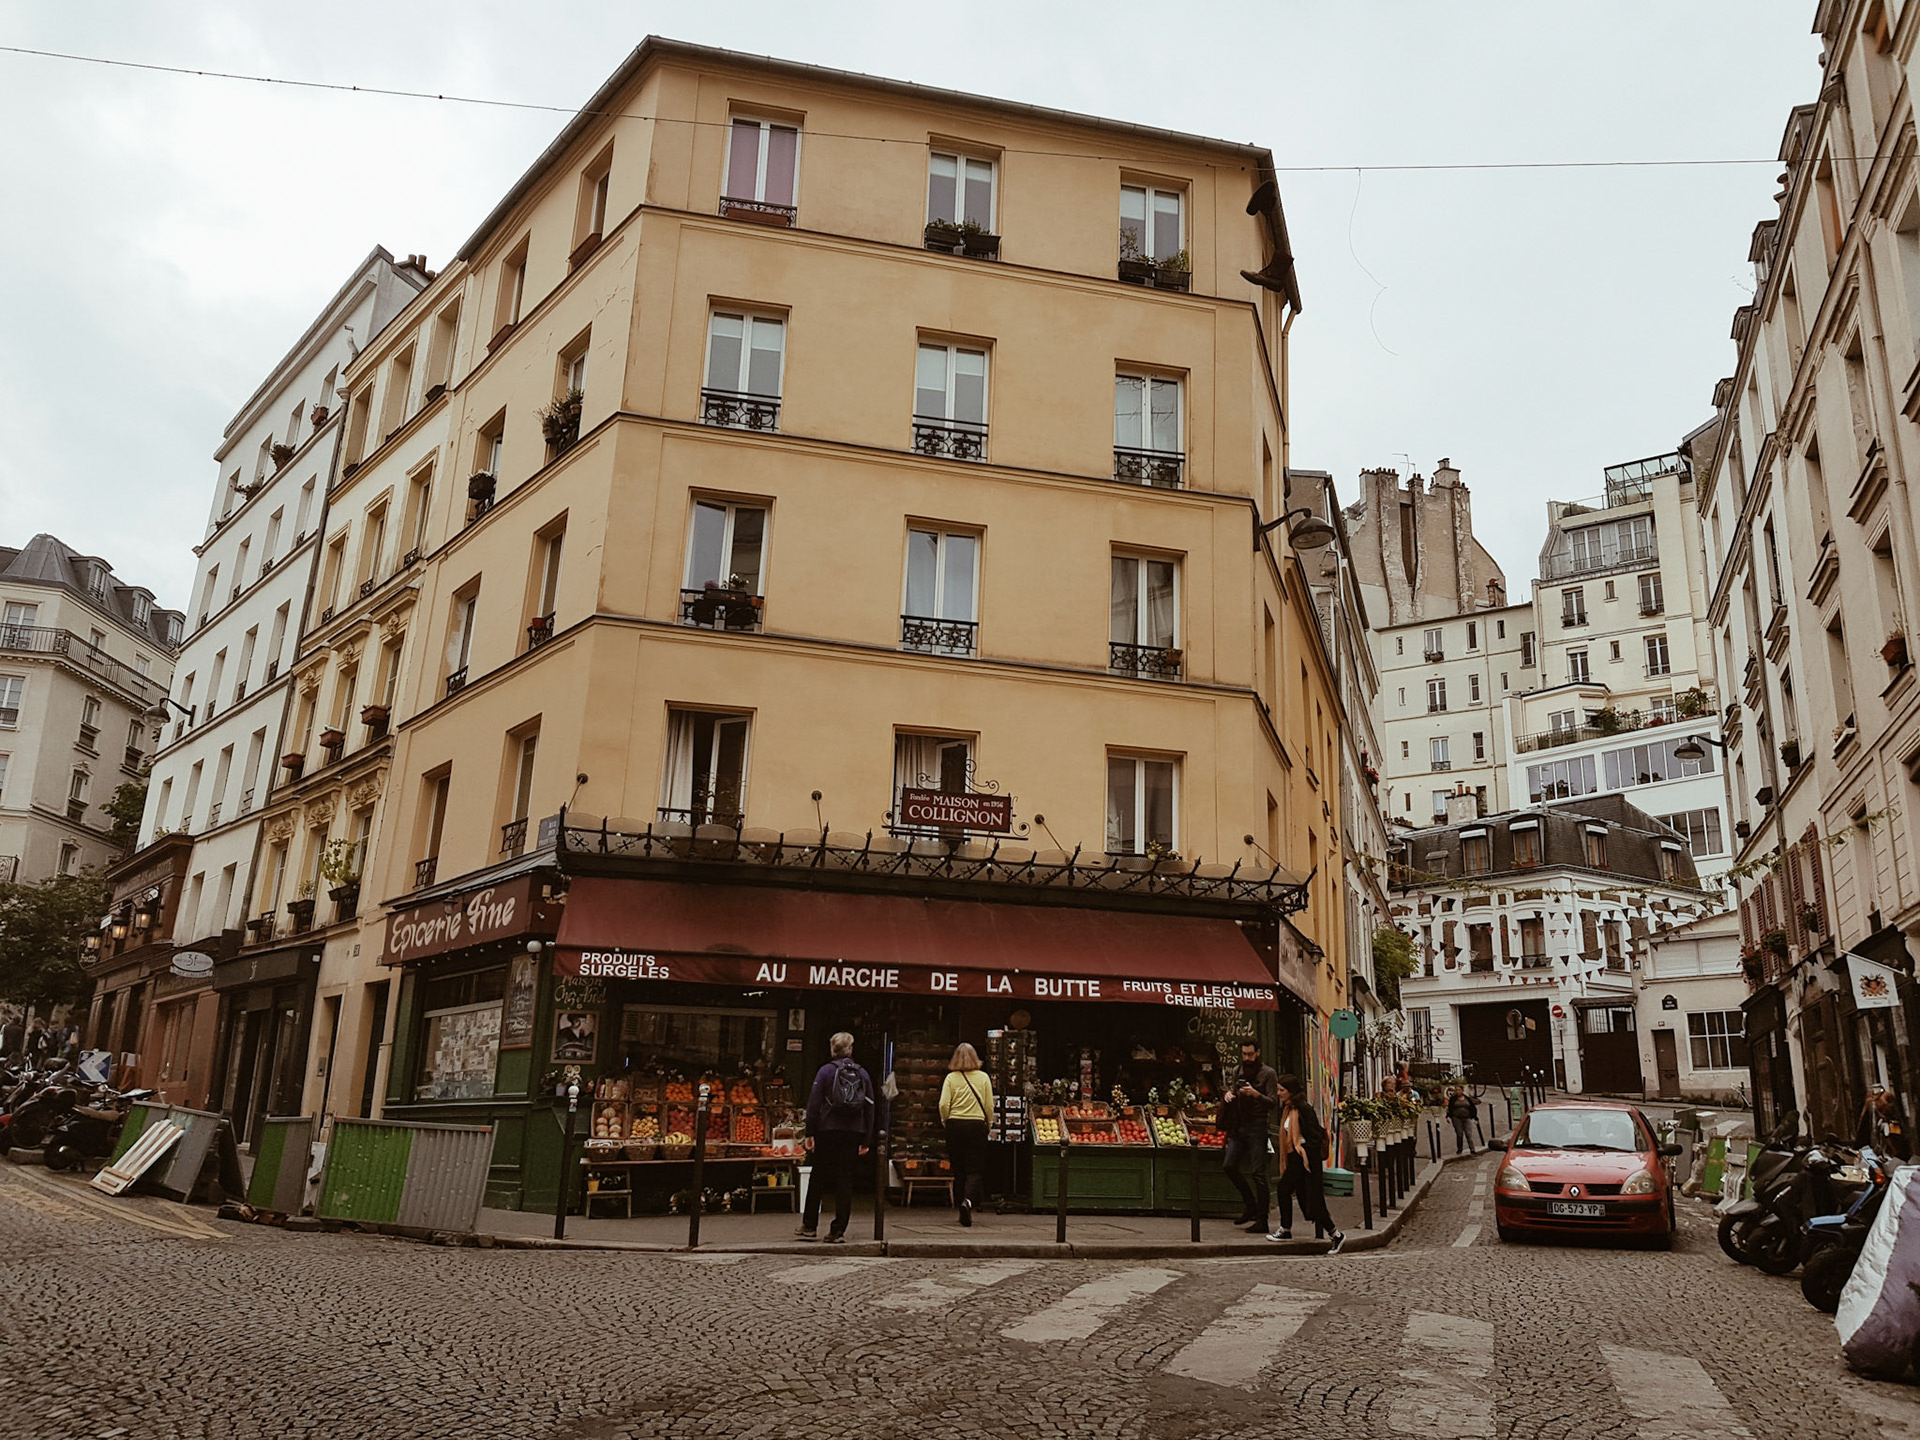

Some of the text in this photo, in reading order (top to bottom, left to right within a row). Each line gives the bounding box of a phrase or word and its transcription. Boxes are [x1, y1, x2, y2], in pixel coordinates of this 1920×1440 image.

[932, 795, 979, 809] MAISON
[908, 804, 1004, 826] COLLIGNON
[390, 888, 516, 960] Epicerie Fine
[581, 952, 656, 967] PRODUITS
[578, 964, 670, 980] SURGELES
[755, 963, 1101, 998] AU MARCHE DE LA BUTTE
[1122, 980, 1274, 1000] FRUITS ET LEGUMES
[1164, 993, 1236, 1009] CREMERIE
